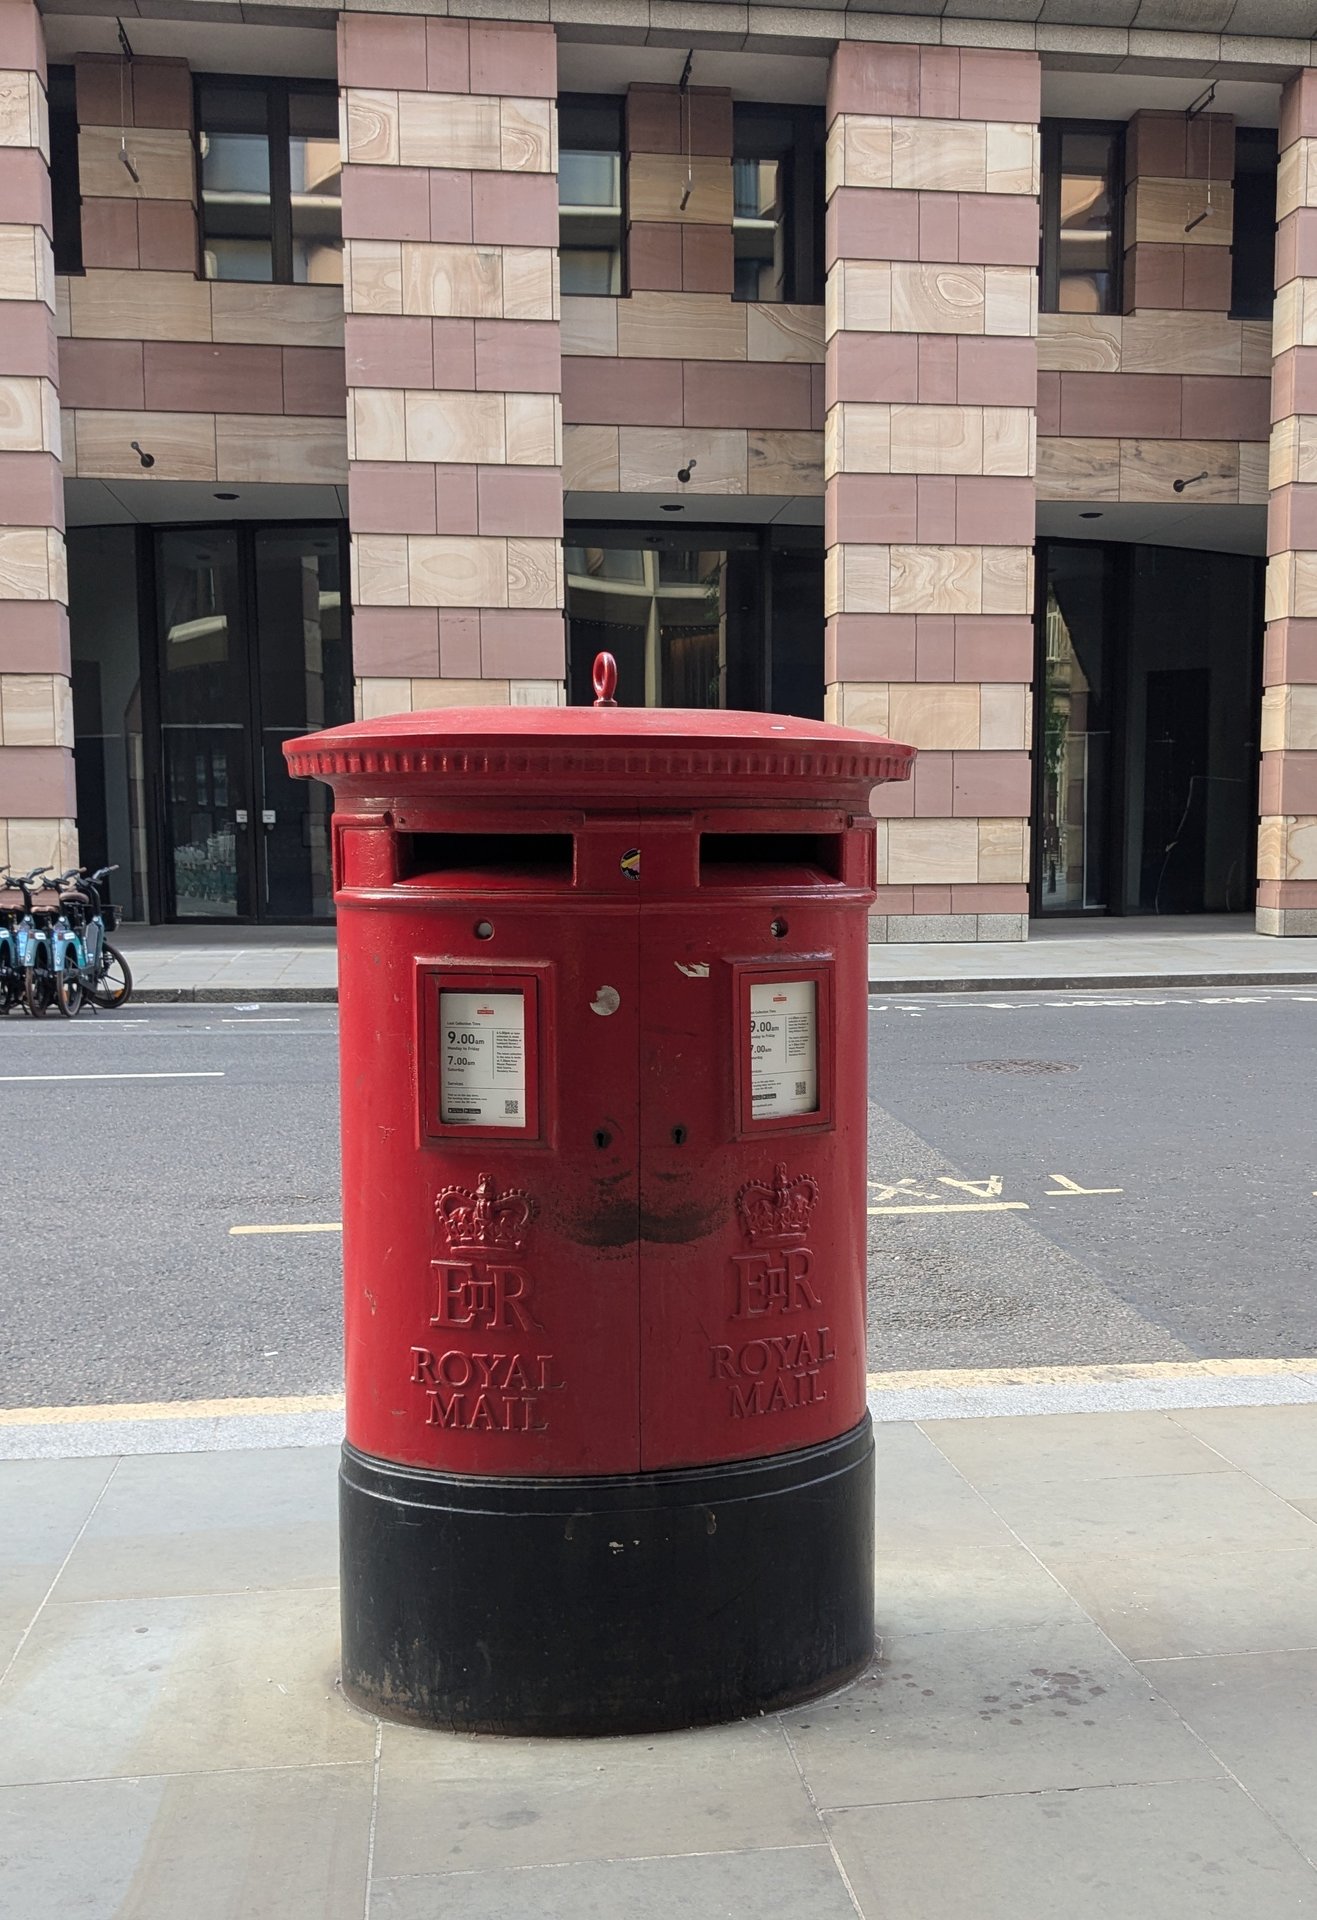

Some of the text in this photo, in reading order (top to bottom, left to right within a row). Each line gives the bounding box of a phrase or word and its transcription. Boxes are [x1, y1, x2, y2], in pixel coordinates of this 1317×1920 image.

[447, 1030, 485, 1045] 9.00am
[447, 1055, 475, 1066] 7.00am
[410, 1346, 568, 1391] ROYAL
[709, 1326, 838, 1380] ROYAL
[425, 1389, 550, 1432] MAIL
[728, 1369, 828, 1419] MAIL
